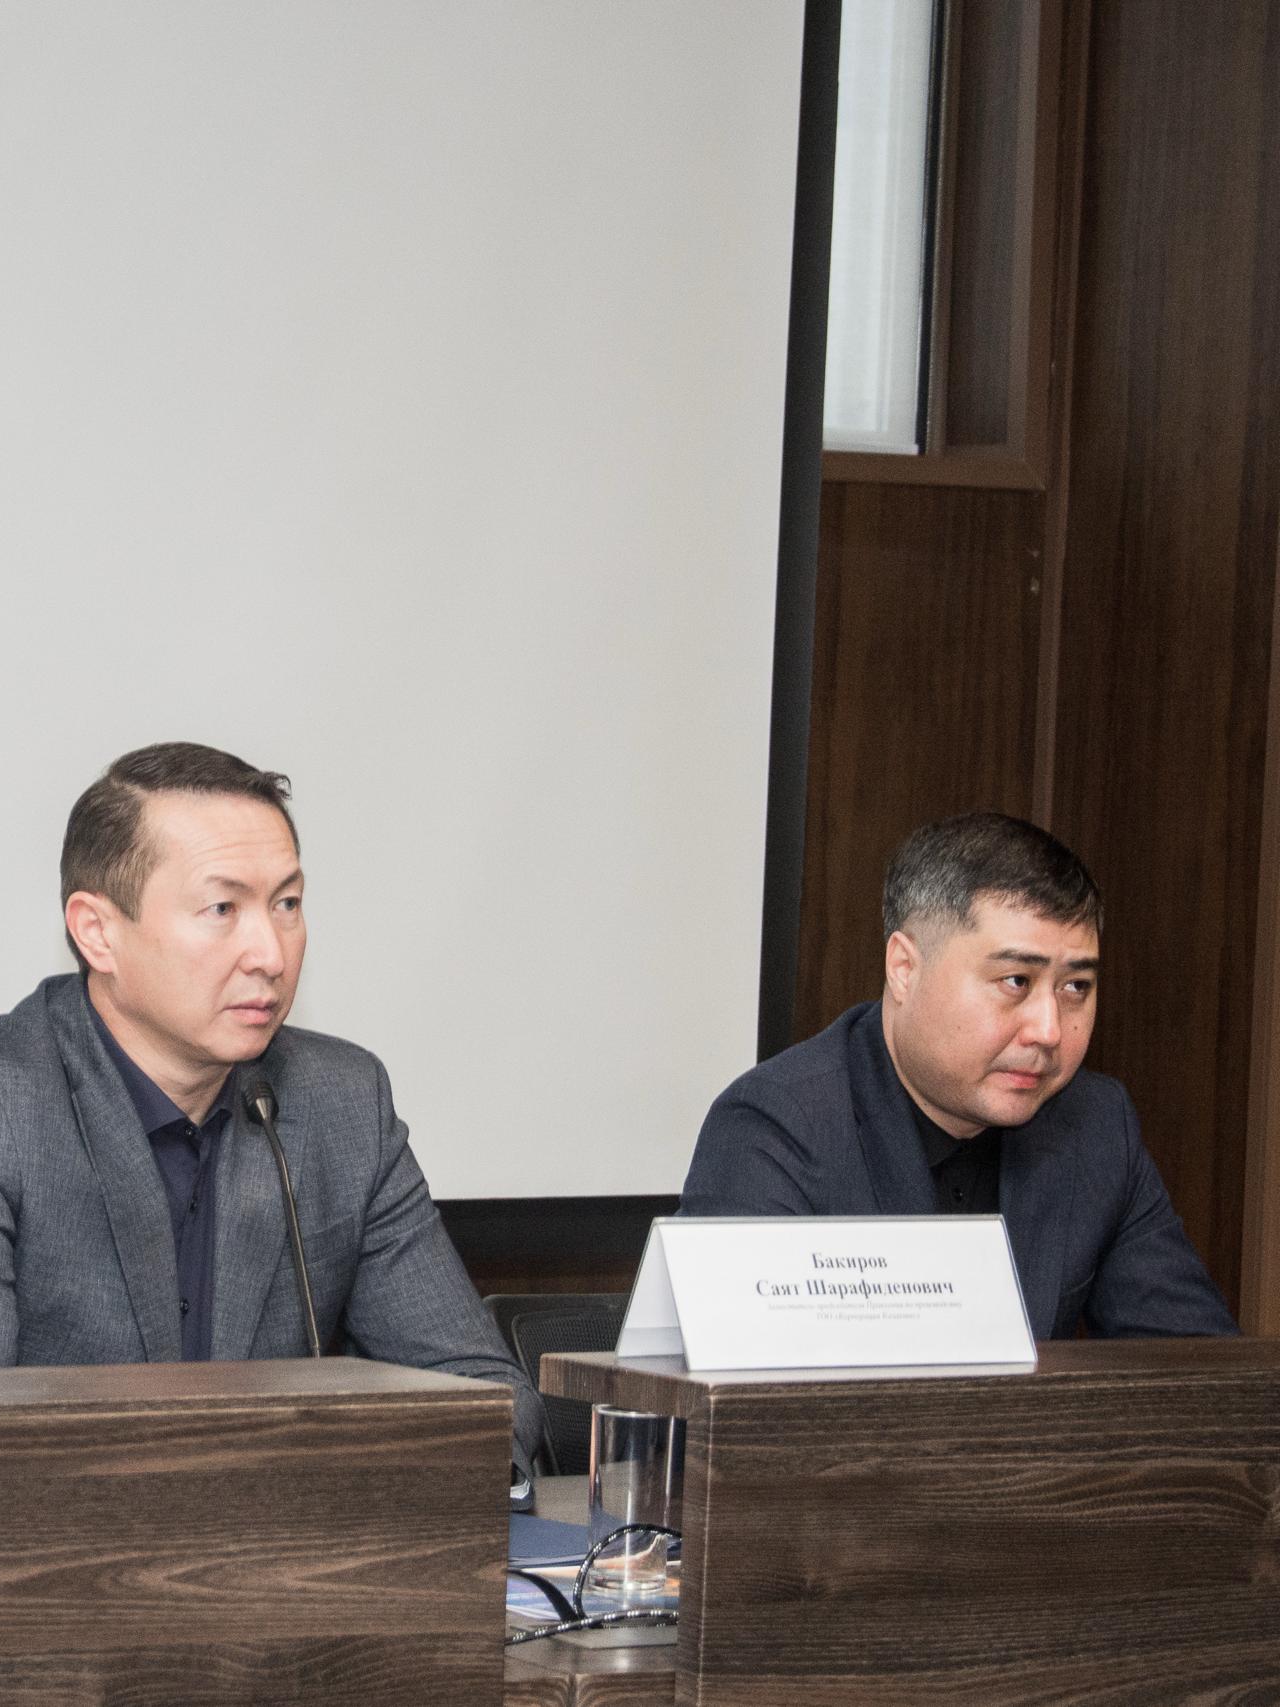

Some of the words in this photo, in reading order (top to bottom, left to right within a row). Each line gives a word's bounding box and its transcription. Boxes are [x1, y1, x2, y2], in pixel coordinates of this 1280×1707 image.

[811, 1252, 888, 1272] Бакиров
[755, 1279, 800, 1297] Саят
[805, 1278, 954, 1299] Шарафиденович
